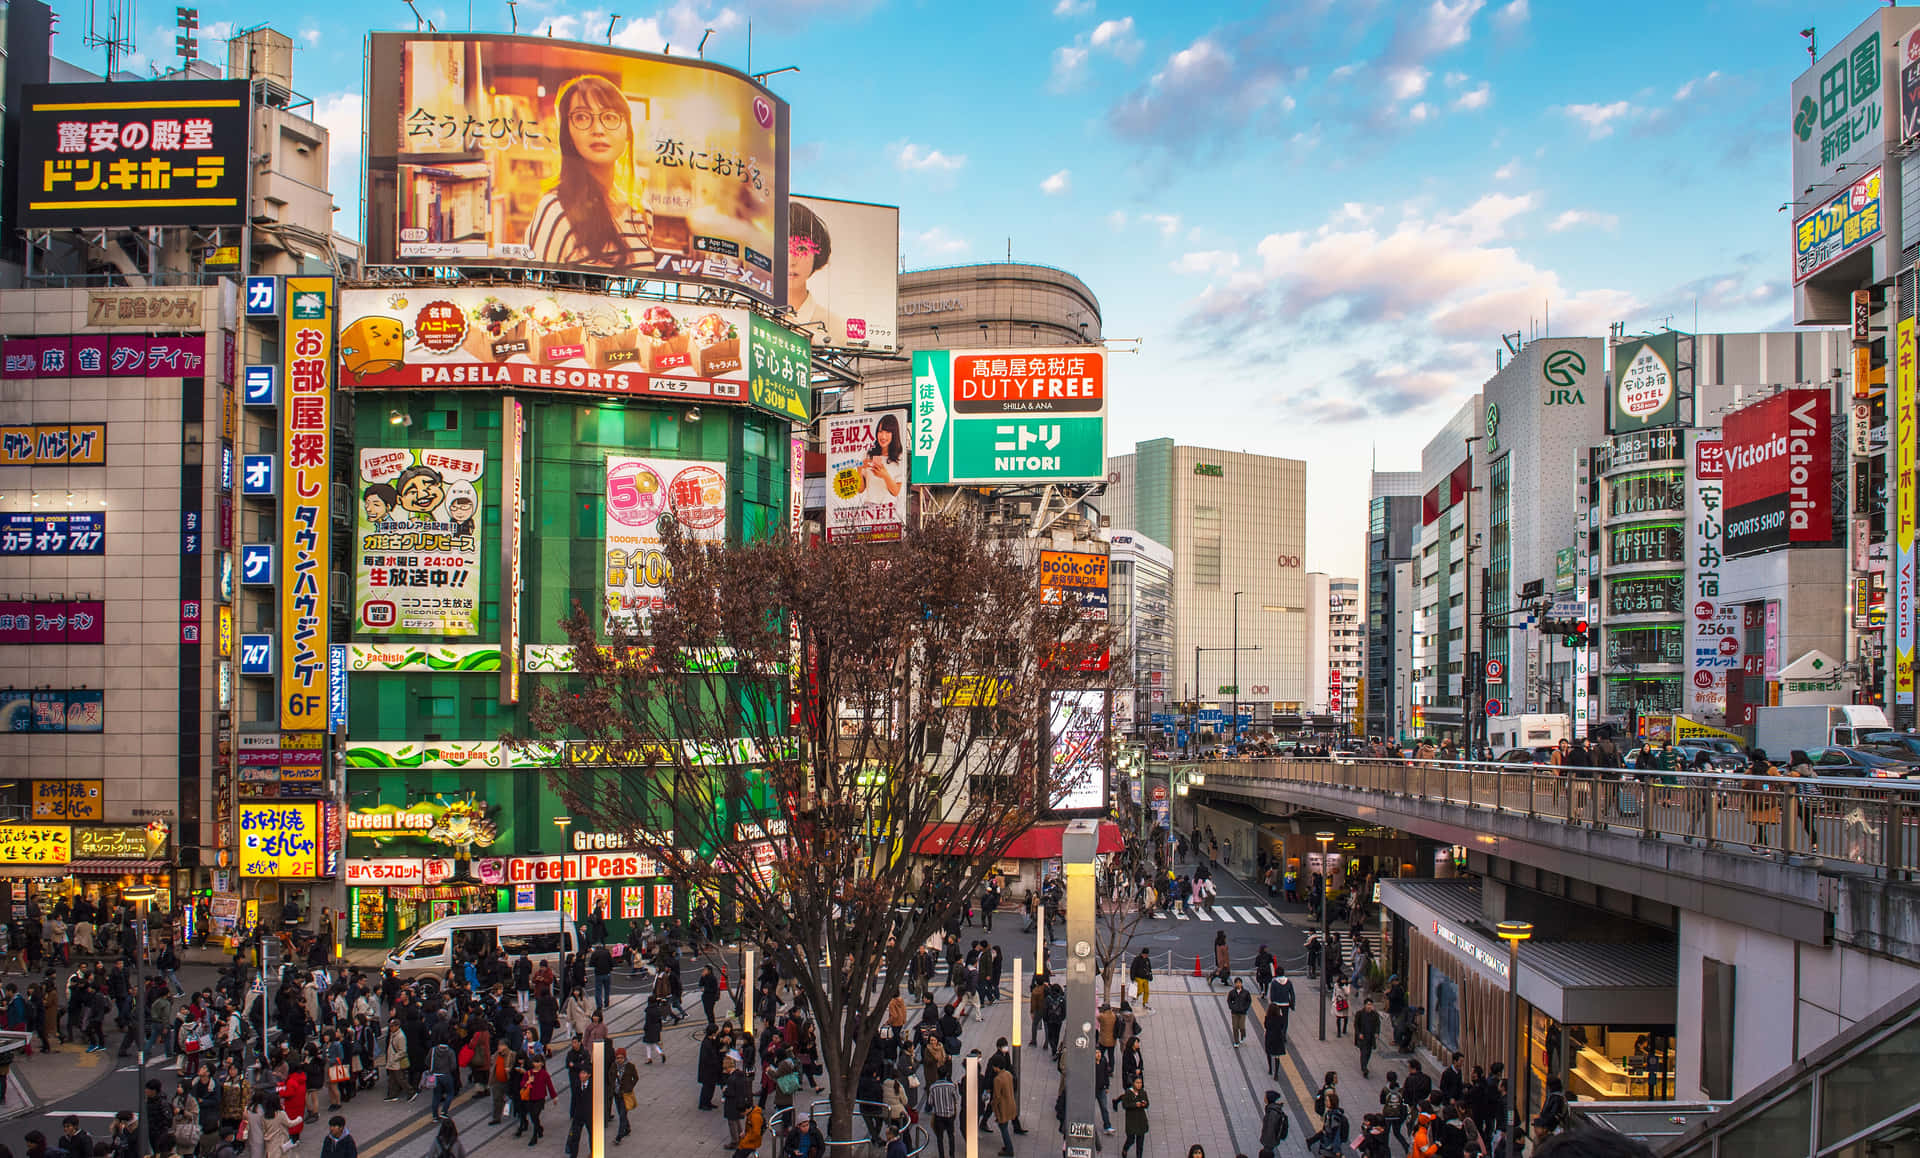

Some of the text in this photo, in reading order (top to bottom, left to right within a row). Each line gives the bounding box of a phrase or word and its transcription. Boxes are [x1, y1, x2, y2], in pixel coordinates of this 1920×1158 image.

[1820, 31, 1880, 131] 田園
[407, 107, 552, 143] 会うたびに、
[58, 120, 213, 153] 驚安の殿堂
[1821, 102, 1882, 167] 新宿ビル
[656, 139, 769, 196] 恋におちる。
[1799, 192, 1850, 253] まんが
[403, 245, 461, 254] ハッピーメール
[502, 246, 524, 255] 検索
[655, 254, 772, 296] ハッピーメール
[92, 298, 116, 318] 7F
[904, 299, 963, 316] OTSUKA
[495, 343, 526, 354] 生チョコ
[551, 349, 581, 357] ミルキー
[608, 351, 634, 361] バナナ
[183, 353, 201, 368] 7F
[661, 356, 685, 366] イチゴ
[708, 360, 739, 370] キャラメル
[752, 343, 808, 388] 安心お宿
[421, 366, 630, 389] PASELA RESORTS
[1623, 373, 1667, 392] 安心お宿
[717, 384, 737, 395] 検索
[1544, 390, 1584, 406] JRA
[1627, 389, 1663, 403] HOTEL
[1003, 402, 1027, 410] SHILLA
[1036, 402, 1053, 410] ANA
[919, 384, 936, 450] 徒歩2分
[831, 425, 875, 445] 高収入
[995, 424, 1061, 450] ニトリ
[3, 431, 97, 459] タウンハウジング
[1725, 433, 1787, 473] Victoria
[364, 452, 405, 468] パチスロの
[426, 454, 479, 475] 伝えます!
[995, 457, 1061, 471] NITORI
[1701, 463, 1723, 473] 以上
[1790, 398, 1817, 530] Victoria
[370, 464, 403, 479] 楽しさを
[674, 478, 704, 507] 新
[291, 328, 326, 687] お部屋探し タウンハウジング
[1615, 496, 1665, 515] LUXURY
[1728, 510, 1785, 539] SPORTS SHOP
[1111, 536, 1132, 545] KEIO
[1615, 531, 1665, 548] CAPSULE
[1698, 486, 1722, 598] 安心お宿
[364, 556, 419, 567] 毎週水曜日
[608, 549, 628, 587] 合計
[370, 568, 469, 588] 生放送中!!
[401, 598, 473, 608] ニコニコ生放送
[1901, 563, 1910, 638] Victoria
[184, 603, 198, 641] 麻雀
[1696, 656, 1738, 667] タブレット
[1745, 657, 1763, 673] 4F
[1789, 682, 1842, 691] 田園新宿ビル
[289, 693, 321, 716] 6F
[15, 719, 30, 729] 3F
[440, 750, 488, 760] Green Peas
[39, 782, 87, 798] お好焼
[52, 800, 93, 817] もんじゃ
[241, 809, 305, 831] お好焼
[347, 811, 434, 830] Green Peas
[5, 846, 47, 860] 生そば
[82, 844, 146, 852] 牛乳ソフトクリーム
[261, 831, 315, 857] もんじゃ
[292, 862, 314, 875] 2F
[348, 865, 422, 879] 選べるスロット
[429, 862, 444, 875] 新
[510, 855, 638, 881] Green Peas
[1475, 946, 1509, 980] INFORMATION
